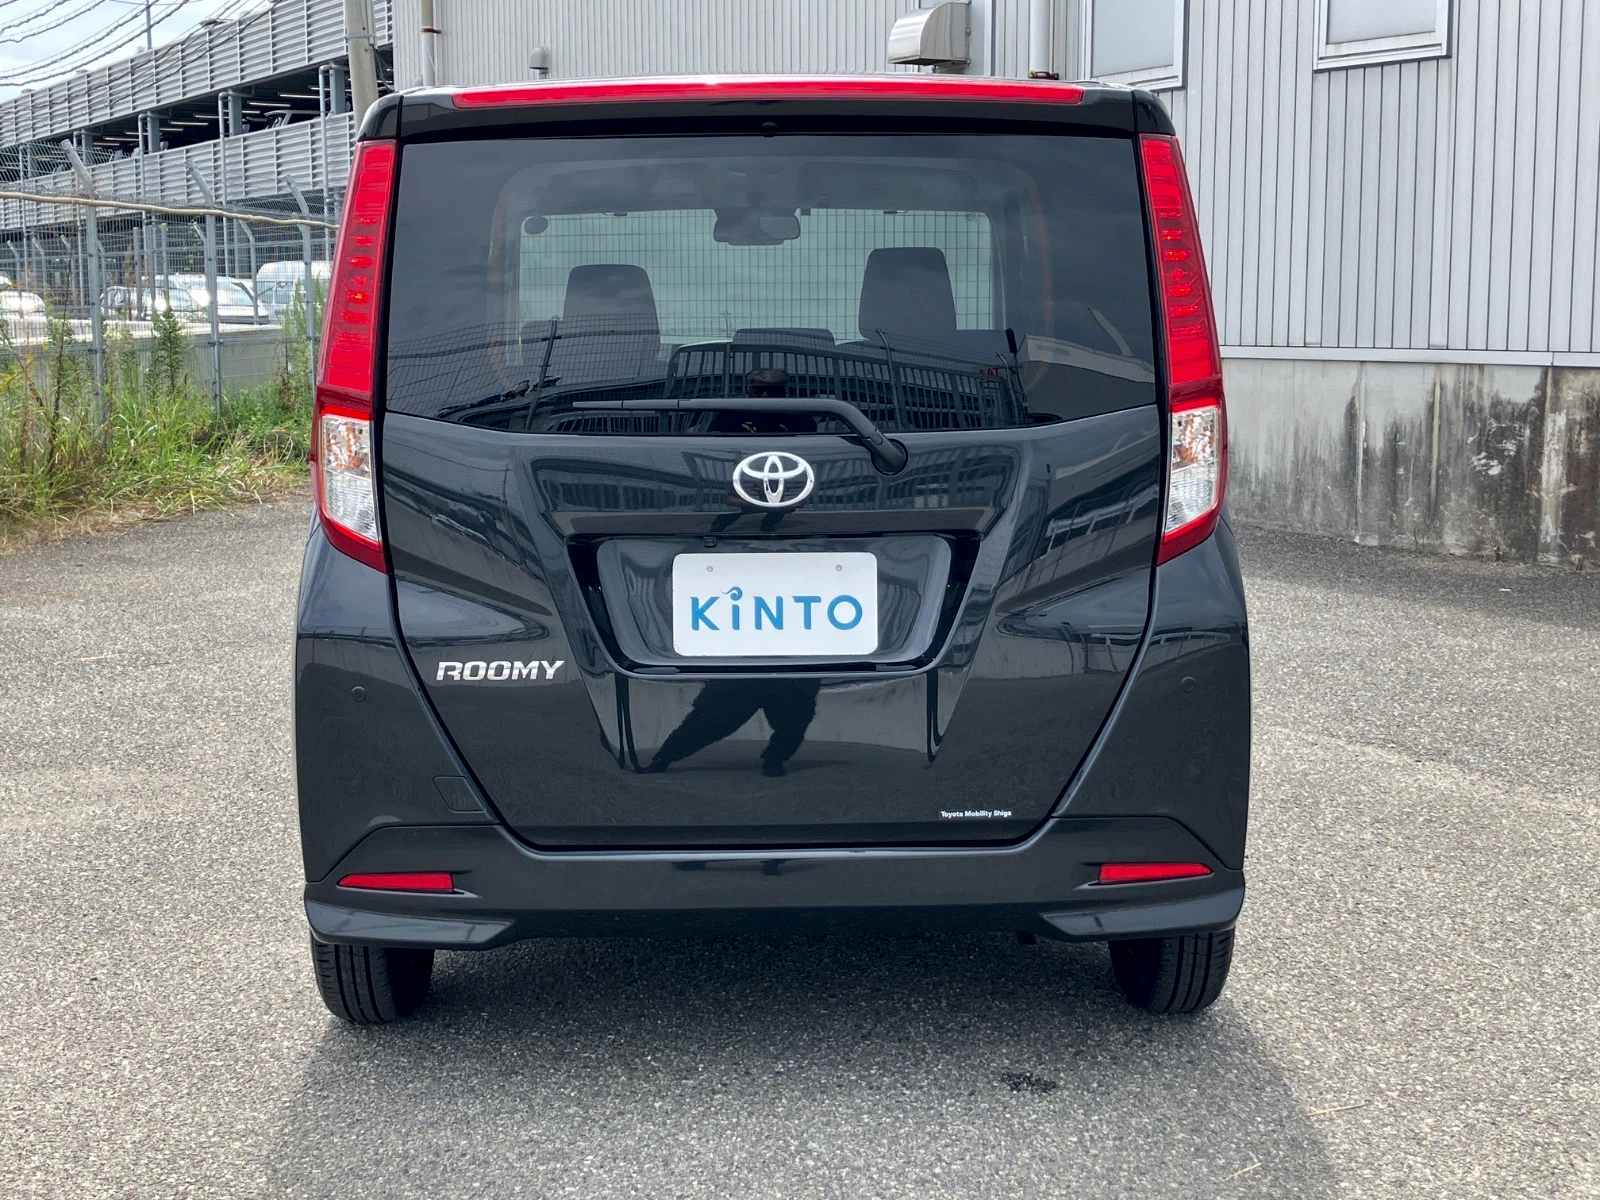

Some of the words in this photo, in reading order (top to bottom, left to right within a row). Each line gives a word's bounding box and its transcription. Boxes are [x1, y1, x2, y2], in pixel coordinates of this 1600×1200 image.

[436, 660, 565, 680] ROOMY
[940, 810, 963, 819] Toyota
[964, 809, 993, 818] Mobility
[993, 809, 1012, 818] Shiga
